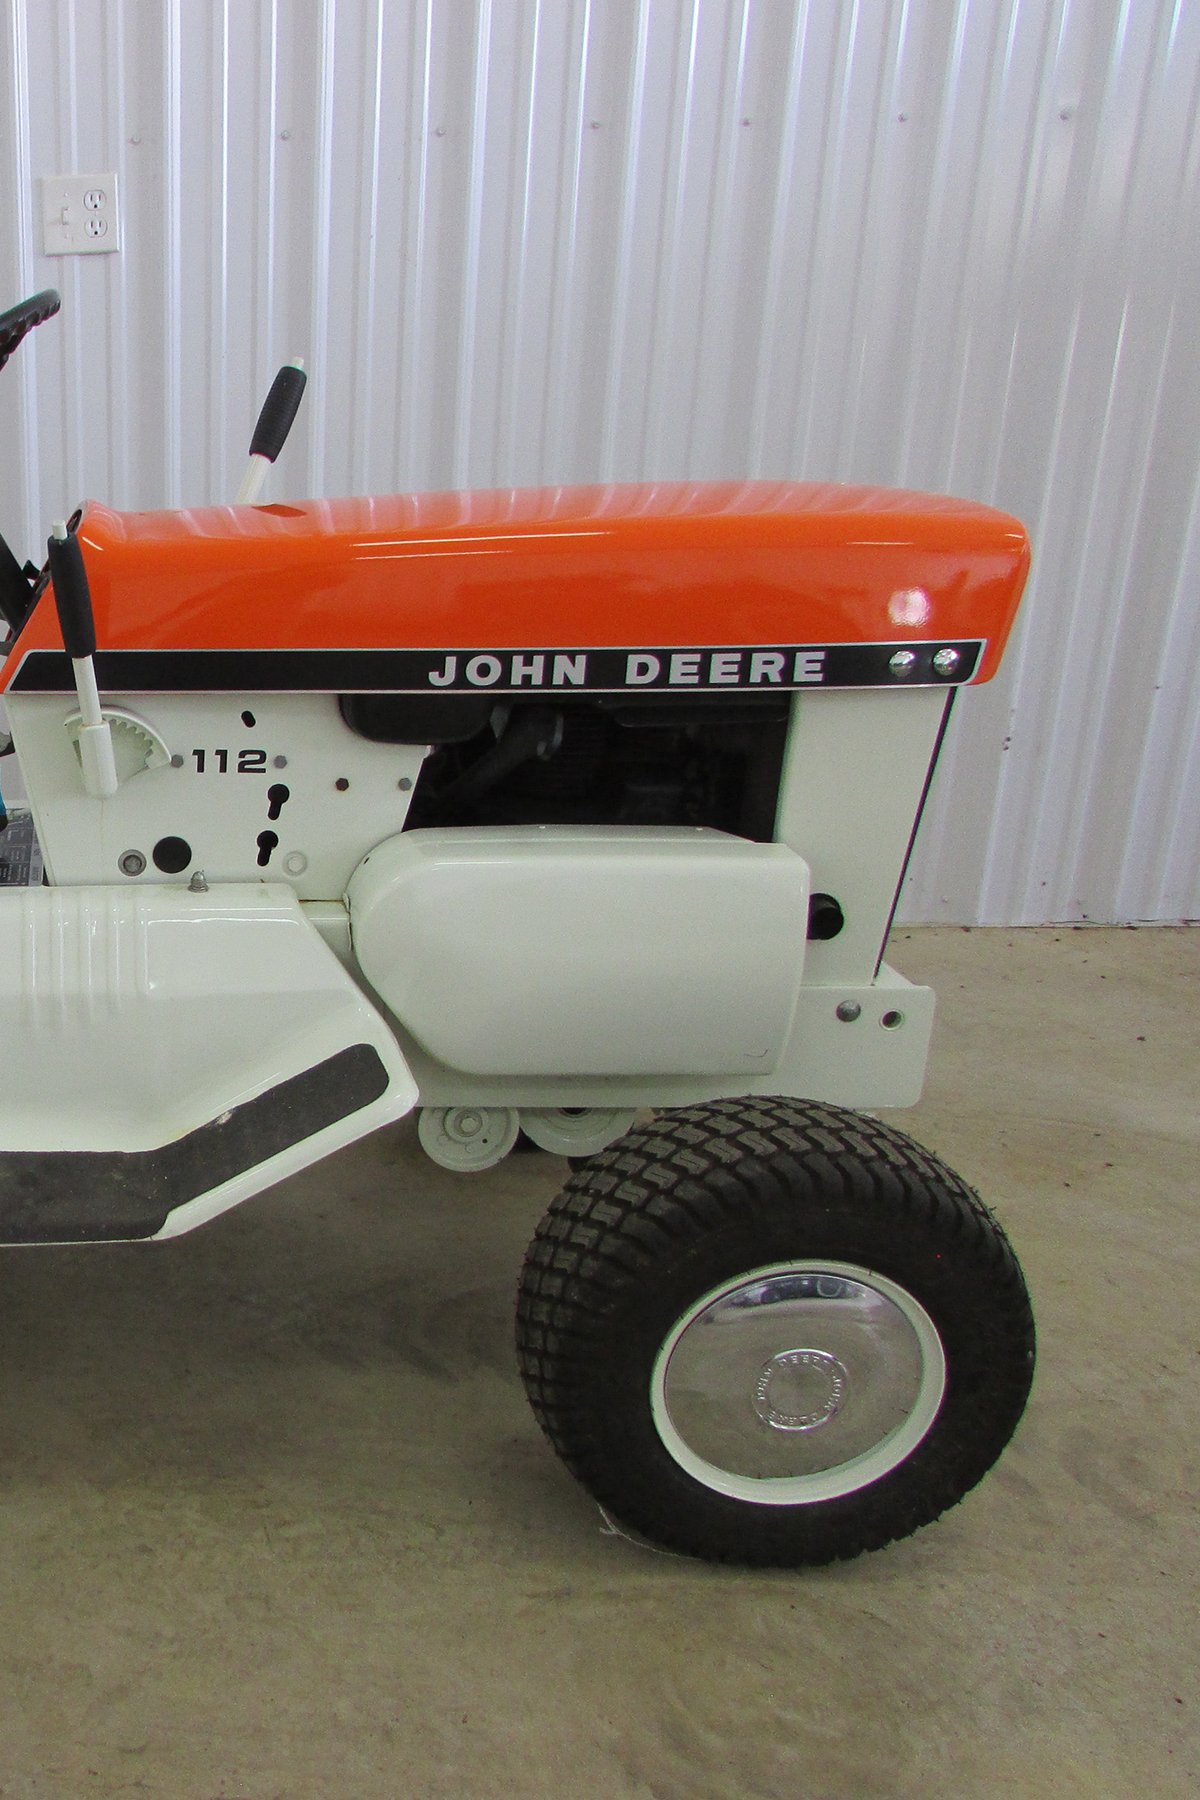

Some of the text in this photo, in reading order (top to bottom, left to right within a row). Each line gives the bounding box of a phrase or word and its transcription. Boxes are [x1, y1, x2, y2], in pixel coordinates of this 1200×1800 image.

[428, 651, 826, 687] JOHN DEERE
[191, 749, 267, 774] 112
